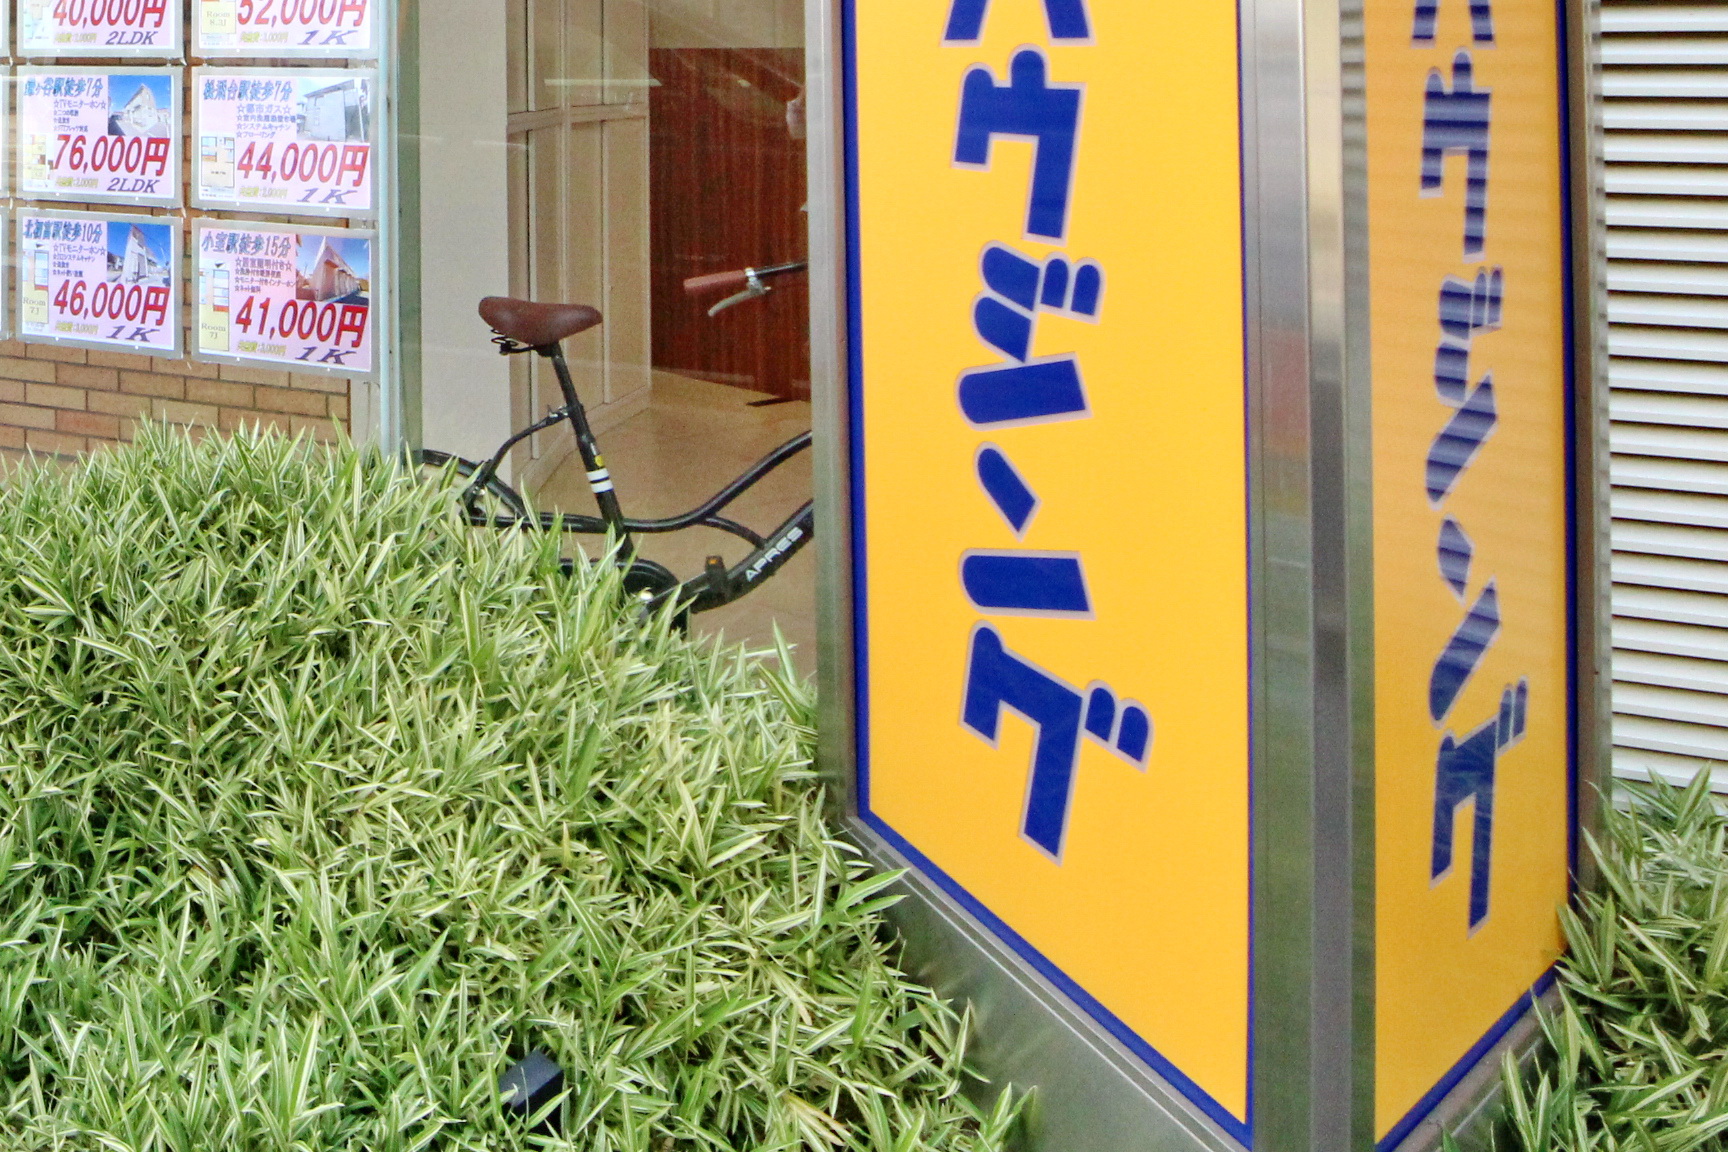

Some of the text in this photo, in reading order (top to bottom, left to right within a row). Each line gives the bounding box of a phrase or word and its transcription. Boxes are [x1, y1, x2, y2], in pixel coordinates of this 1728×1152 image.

[105, 31, 159, 46] 2LDK
[297, 29, 359, 45] 1K
[54, 134, 171, 177] 76,000円
[237, 141, 370, 187] 44,000円
[107, 177, 160, 193] 2LDK
[296, 187, 358, 204] 1K
[53, 279, 170, 326] 46,000円
[235, 296, 369, 348] 41,000円
[106, 325, 160, 342] 1K
[295, 346, 356, 365] 1K
